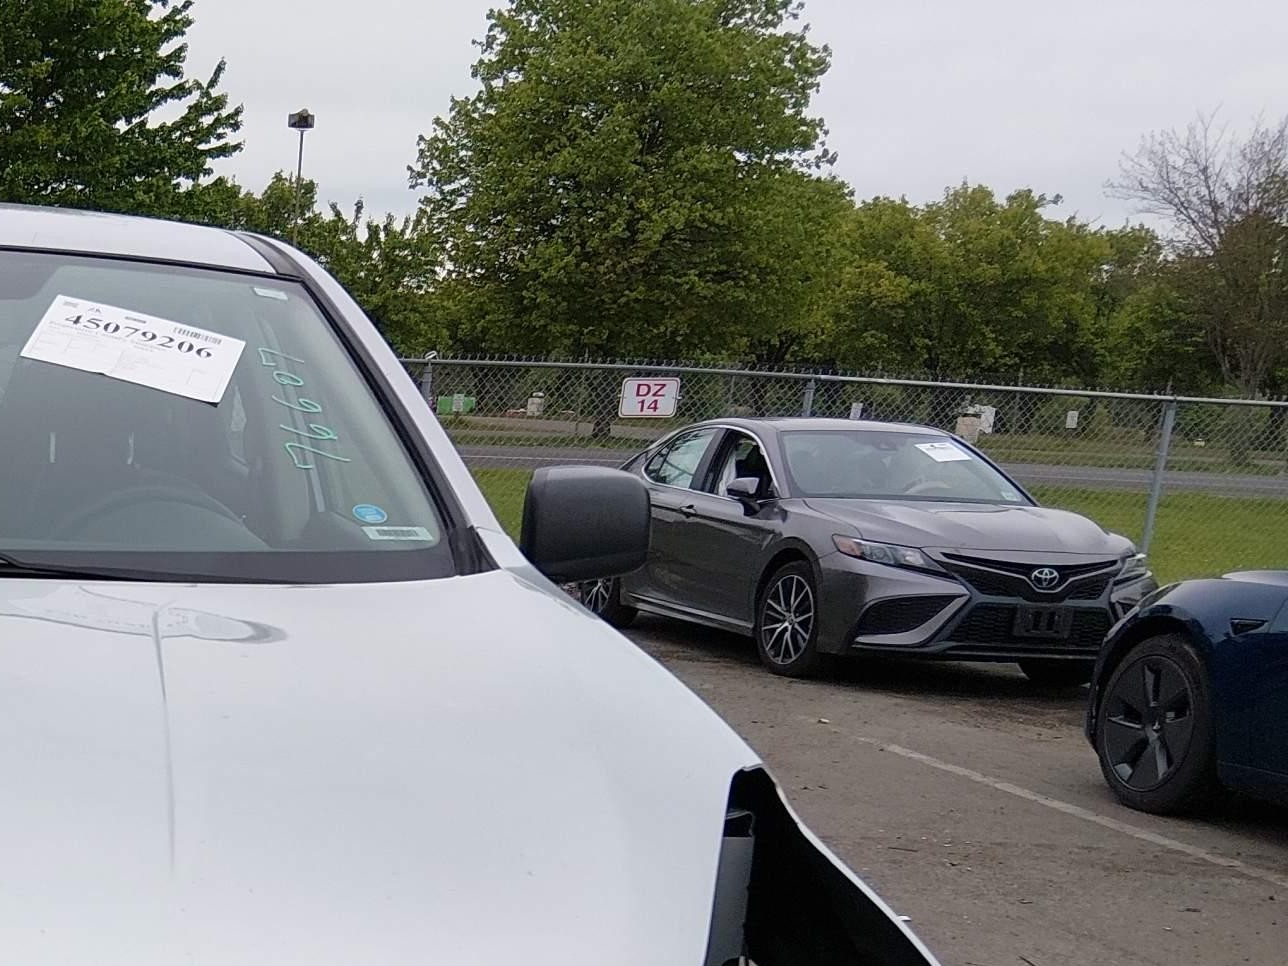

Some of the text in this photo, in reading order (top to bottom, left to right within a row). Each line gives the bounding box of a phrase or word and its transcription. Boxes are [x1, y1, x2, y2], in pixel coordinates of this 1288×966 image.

[64, 313, 213, 360] 45079206
[635, 383, 666, 397] DZ
[258, 347, 351, 469] 76607
[637, 399, 659, 412] 14
